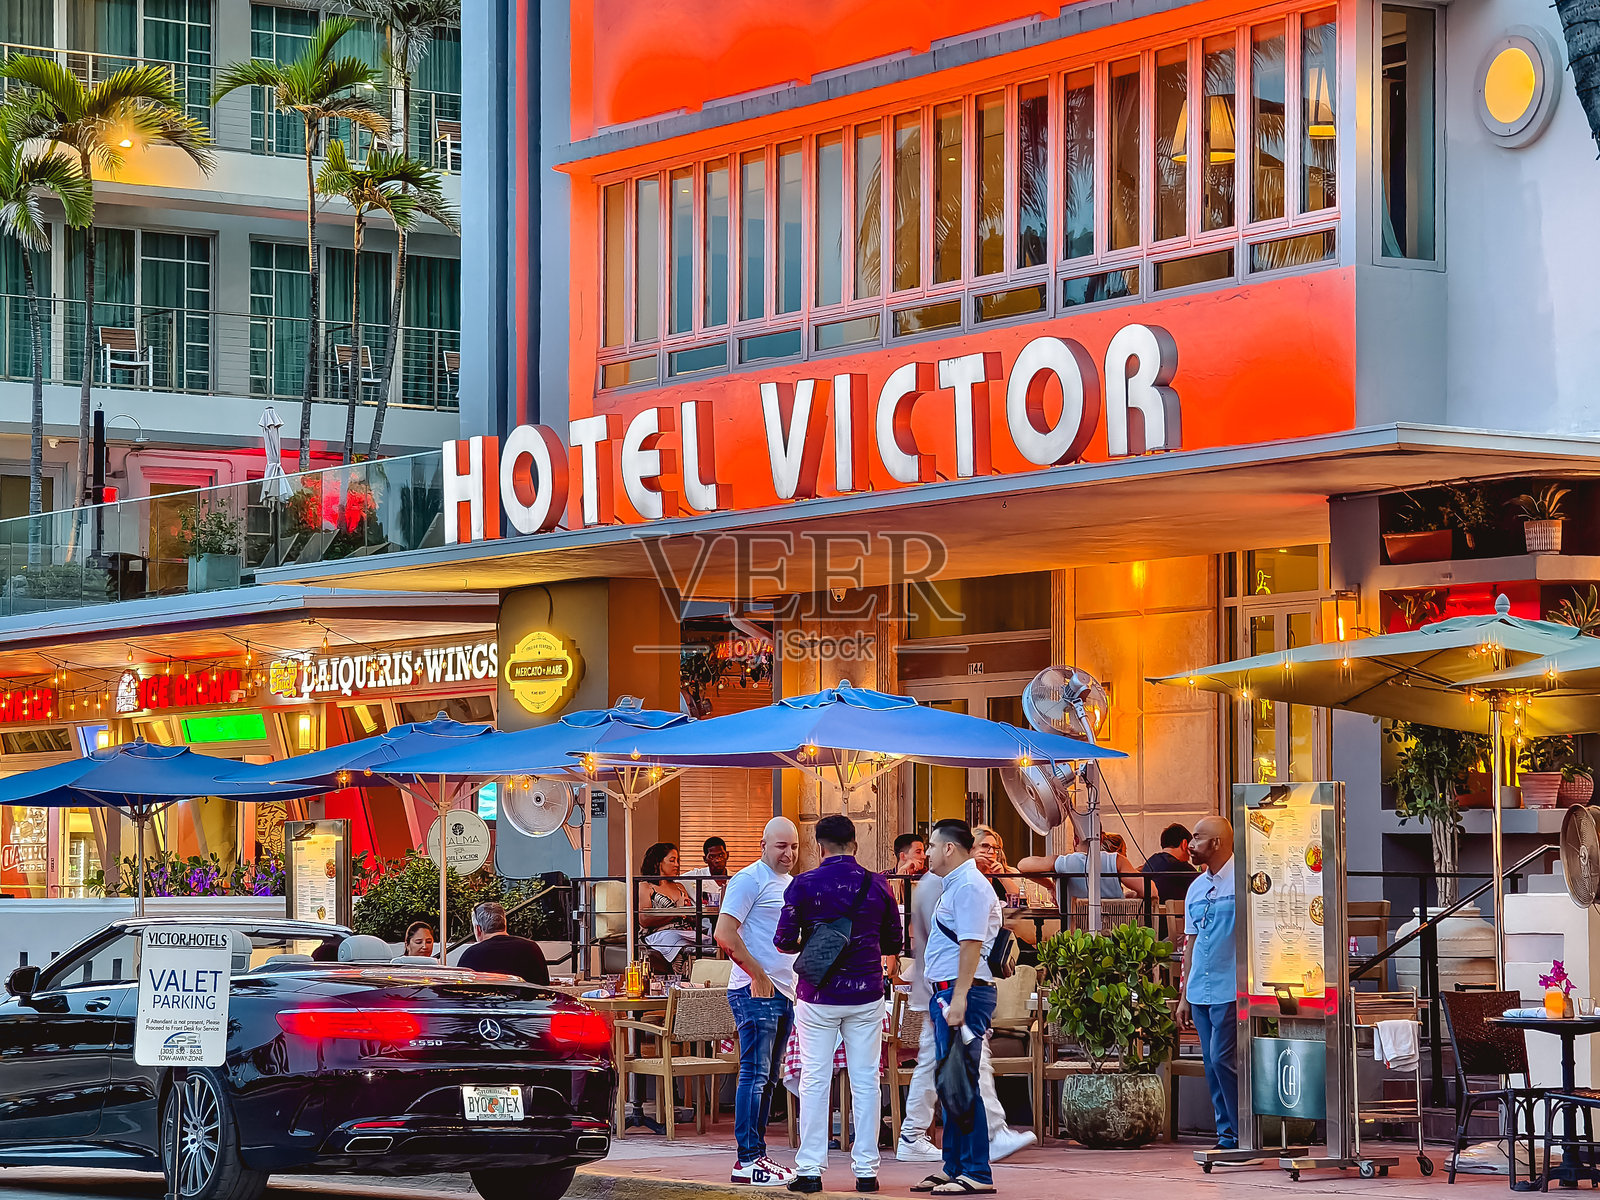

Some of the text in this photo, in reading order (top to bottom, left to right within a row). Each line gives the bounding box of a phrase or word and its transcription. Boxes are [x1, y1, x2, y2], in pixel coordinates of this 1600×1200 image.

[443, 324, 1178, 544] HOTEL VICTOR
[515, 664, 563, 677] MERCATO MARE
[969, 663, 983, 675] 1144
[138, 675, 170, 710] ICE
[175, 670, 241, 708] CREAM
[0, 688, 53, 722] URGER
[148, 932, 228, 947] VICTOR HOTELS
[149, 969, 223, 993] VALET
[152, 994, 216, 1010] PARKING
